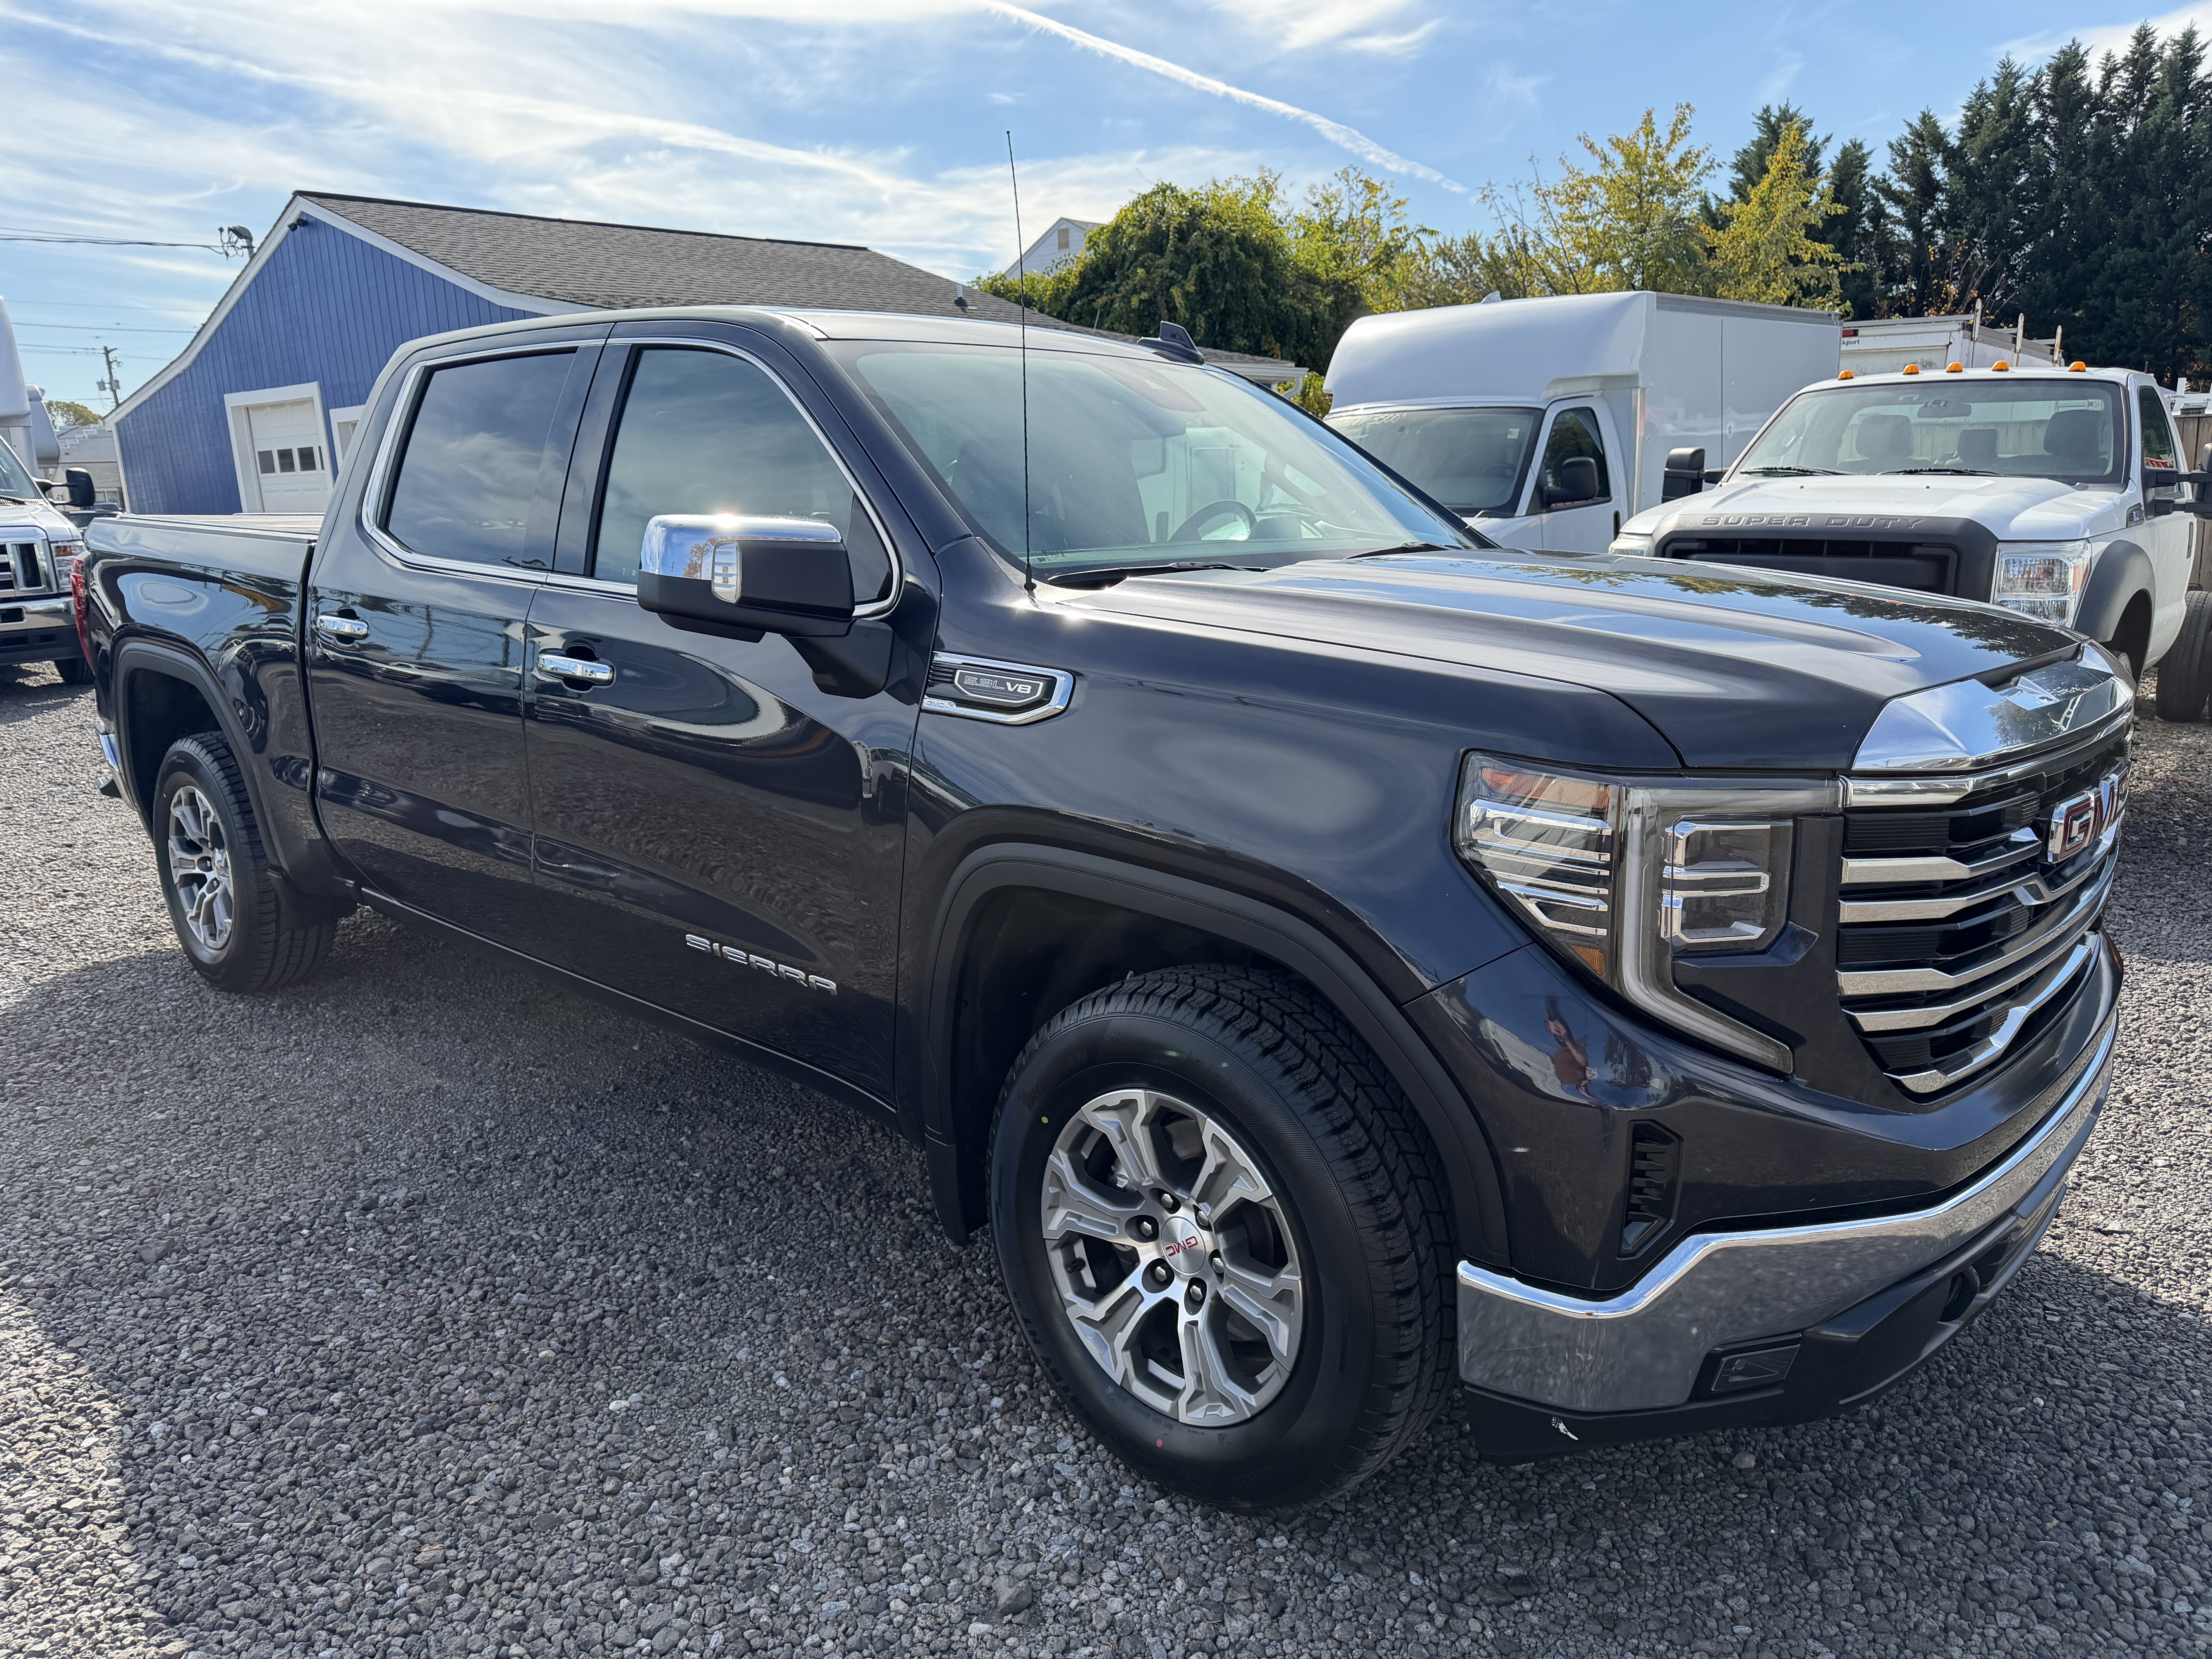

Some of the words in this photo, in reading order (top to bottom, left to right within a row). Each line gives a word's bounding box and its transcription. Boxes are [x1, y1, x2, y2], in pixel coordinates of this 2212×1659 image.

[1702, 515, 1810, 527] SUPER
[1824, 516, 1925, 529] DUTY
[964, 676, 1005, 690] 5.3L
[1006, 682, 1031, 694] V8
[685, 934, 838, 996] SIERRA
[1165, 1236, 1198, 1257] GMC
